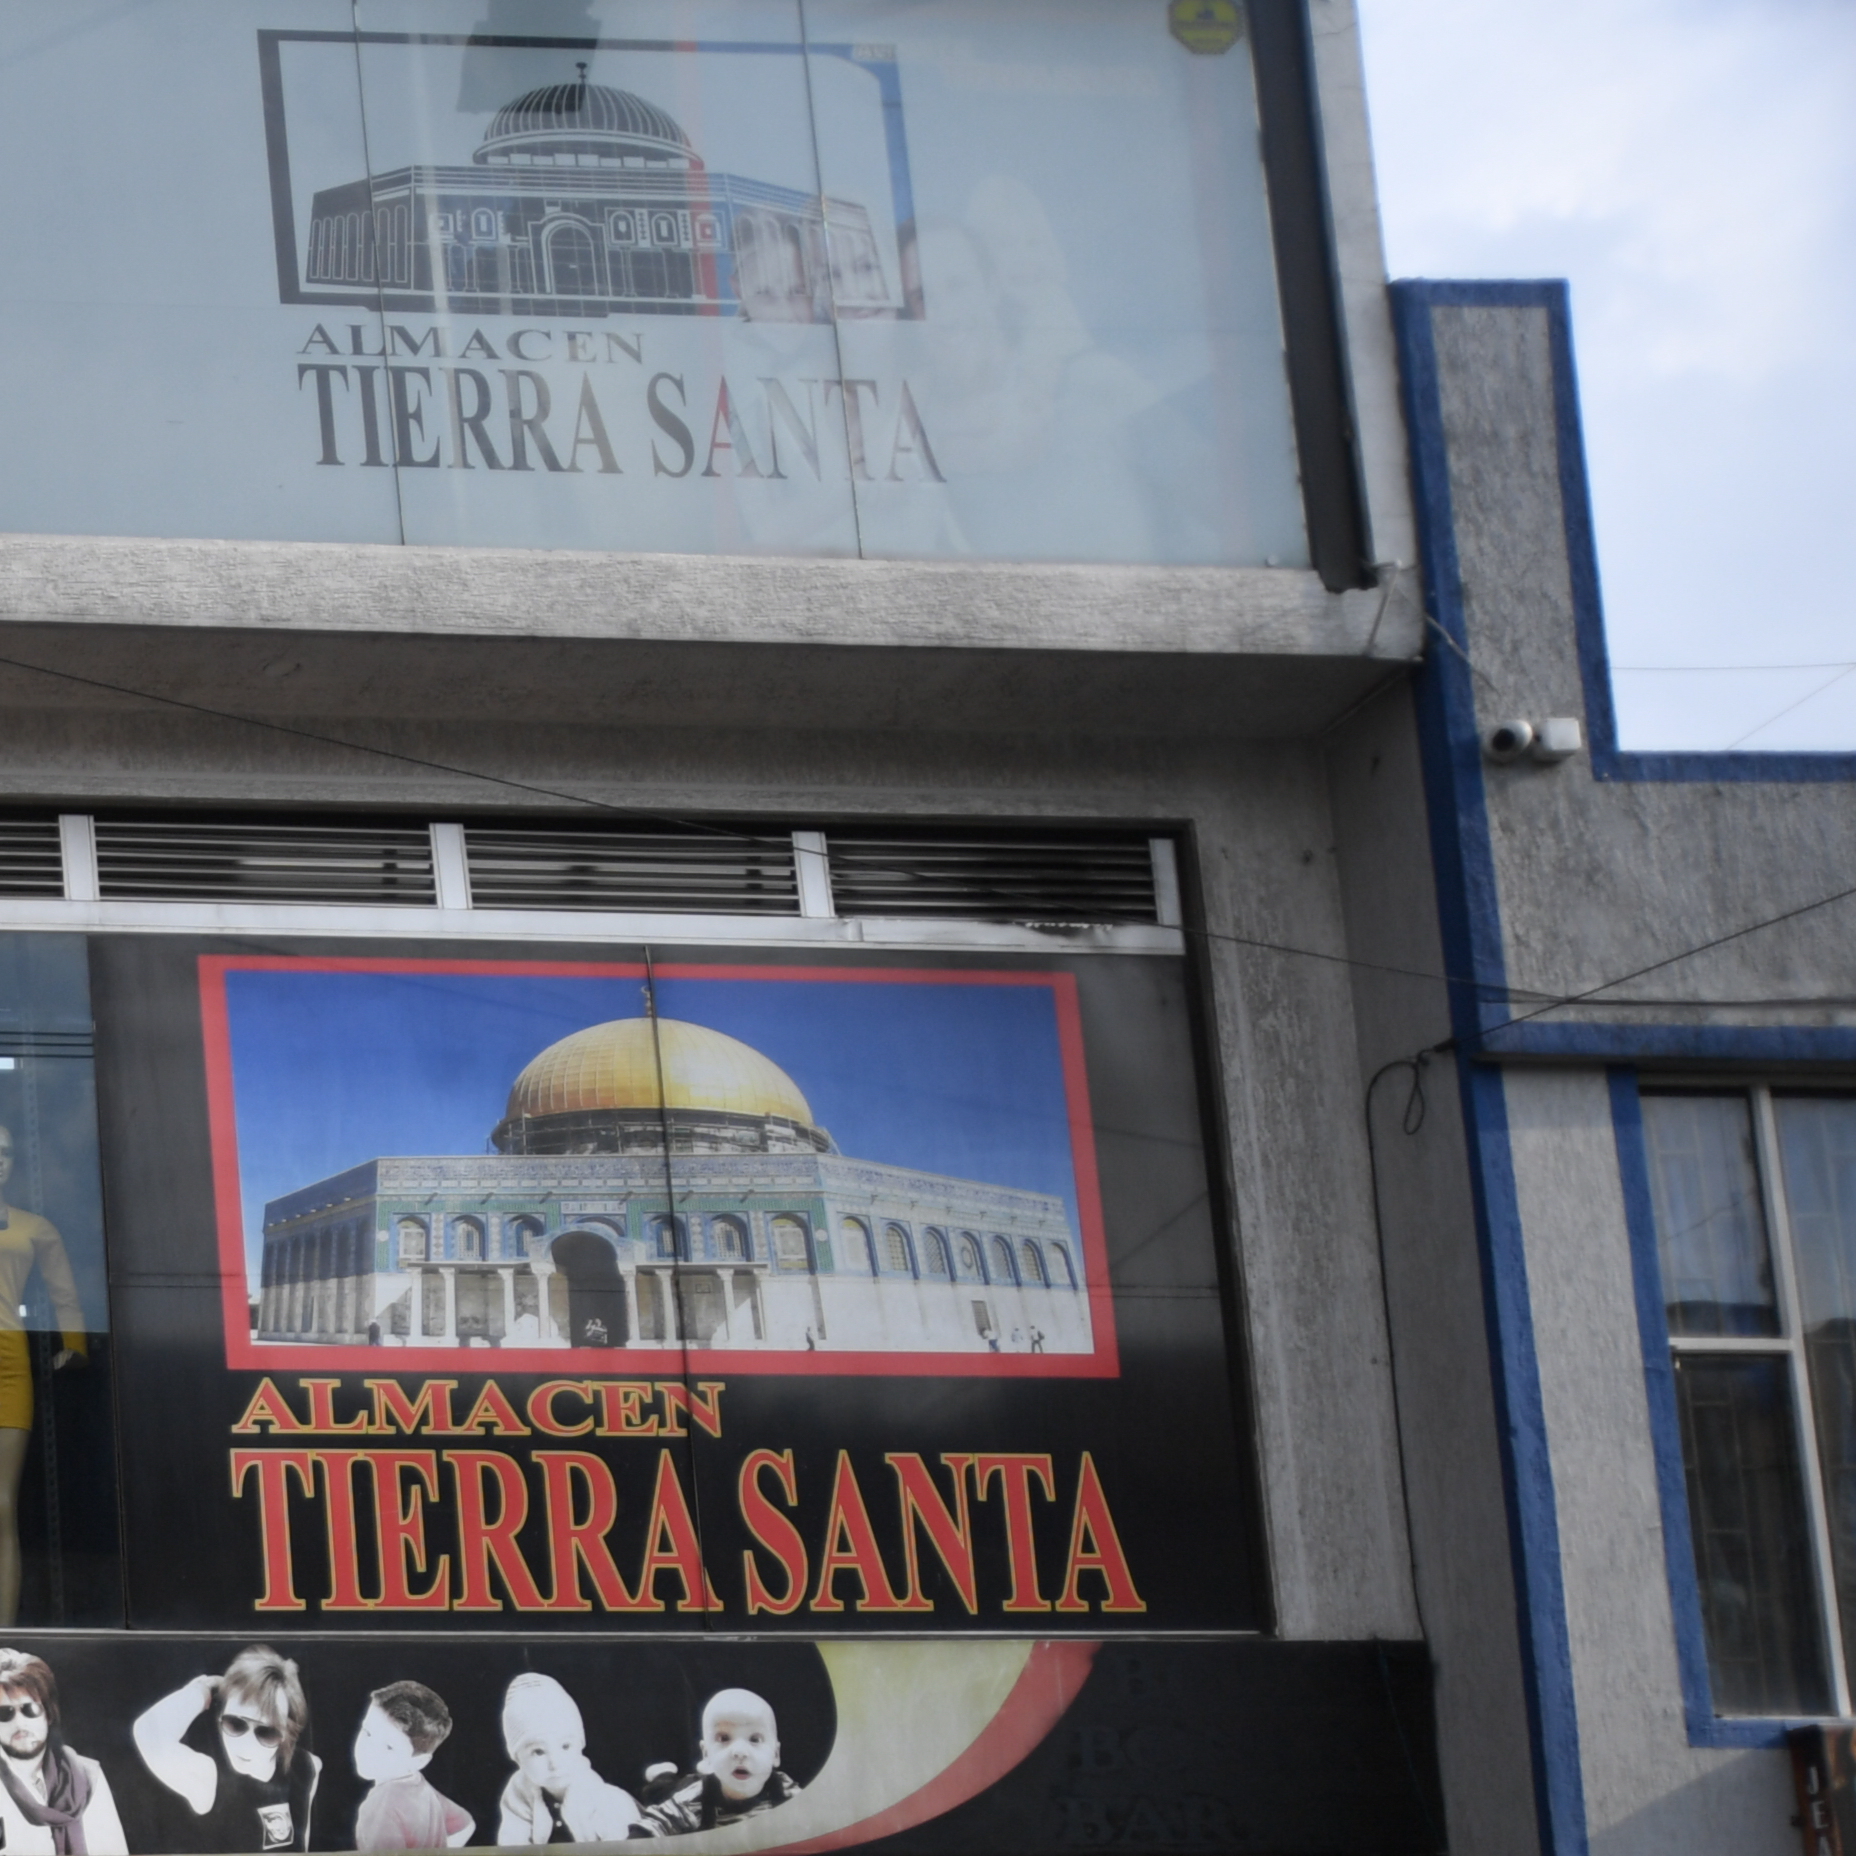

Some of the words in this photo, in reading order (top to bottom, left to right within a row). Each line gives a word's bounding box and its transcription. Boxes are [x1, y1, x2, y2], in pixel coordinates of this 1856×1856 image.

[295, 323, 644, 364] ALMACEN
[297, 362, 624, 475] TIERRA
[649, 371, 948, 484] SANTA
[230, 1377, 726, 1438] ALMACEN
[229, 1447, 725, 1613] TIERRA
[739, 1447, 1147, 1616] SANTA
